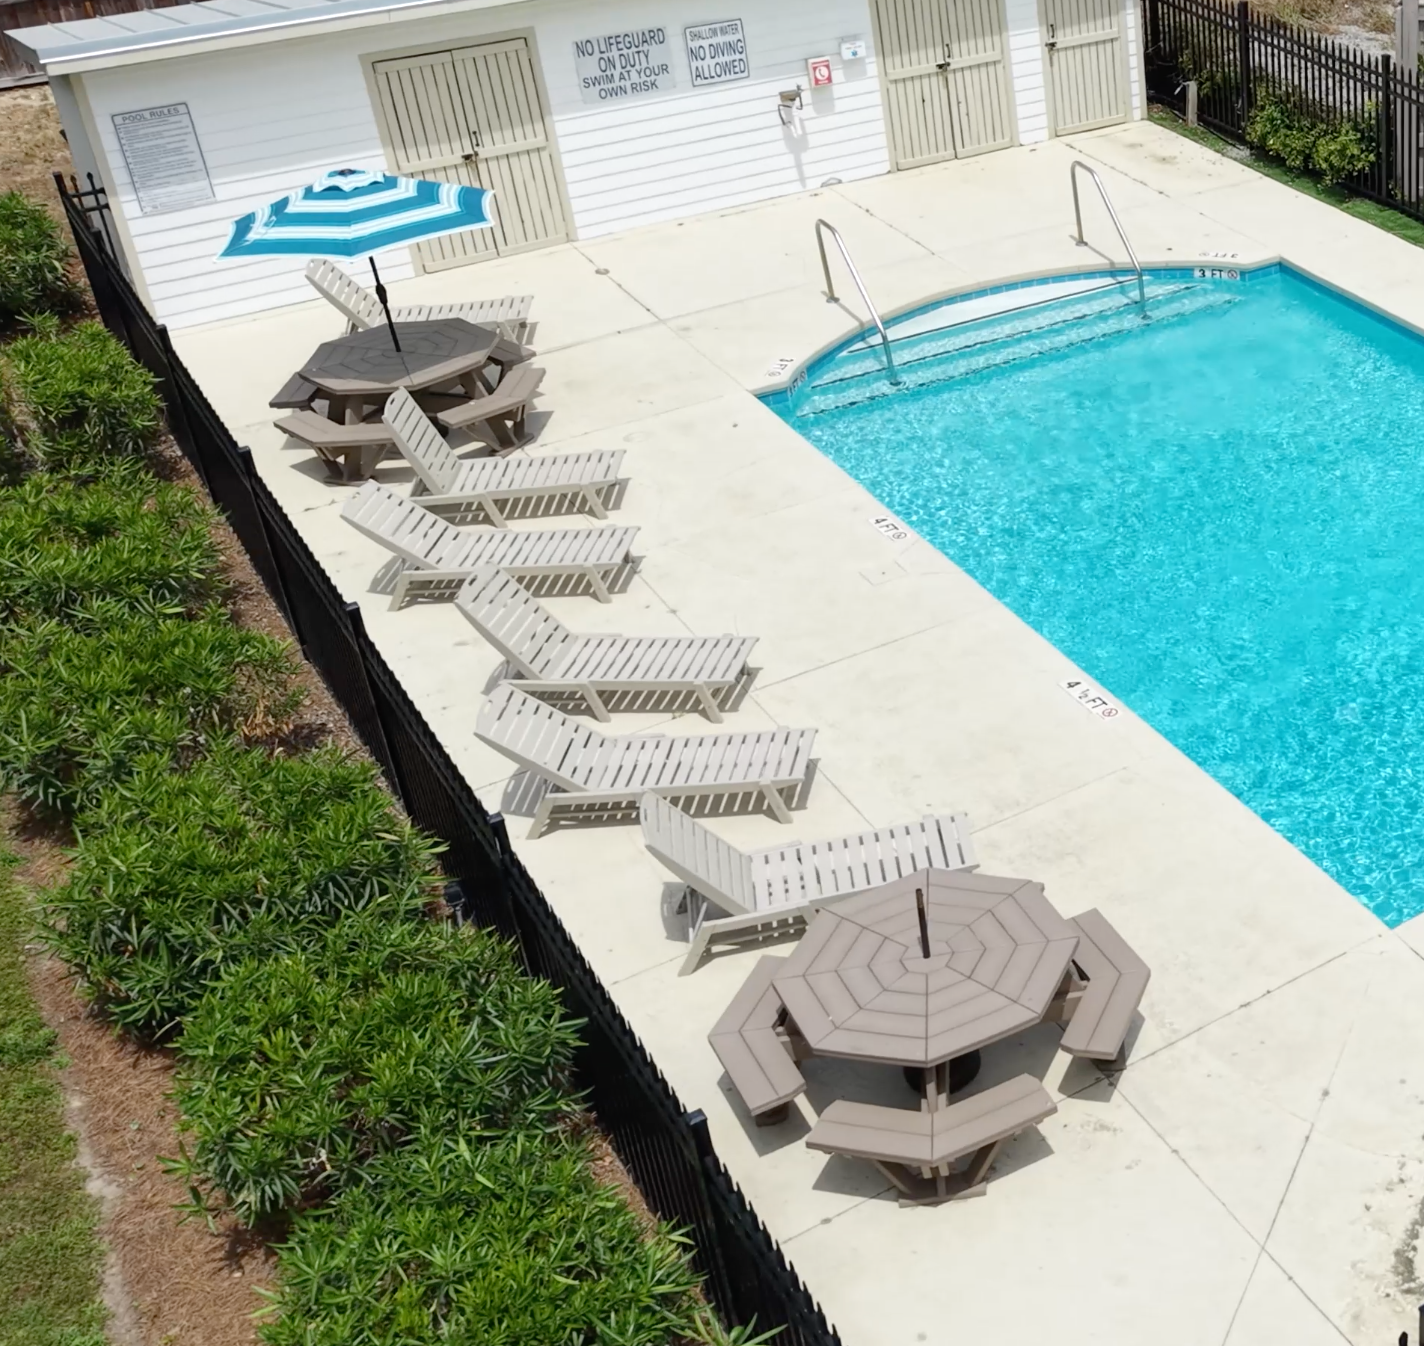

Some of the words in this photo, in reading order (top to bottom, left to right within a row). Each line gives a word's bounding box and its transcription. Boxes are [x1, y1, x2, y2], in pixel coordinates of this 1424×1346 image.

[575, 40, 595, 58] NO
[597, 28, 666, 54] LIFEGUARD
[689, 28, 719, 42] SHALLOW
[719, 23, 740, 36] WATER
[598, 56, 616, 73] ON
[620, 50, 650, 69] DUTY
[690, 46, 706, 62] NO
[709, 39, 745, 59] DIVING
[583, 73, 615, 89] SWIM
[618, 69, 632, 82] AT
[635, 64, 670, 79] YOUR
[695, 59, 746, 81] ALLOWED
[599, 86, 628, 100] OWN
[631, 79, 659, 94] RISK
[121, 114, 148, 123] POOL
[150, 107, 180, 118] RULES
[1198, 269, 1206, 278] 3
[1211, 269, 1224, 279] FT
[878, 523, 899, 533] FT
[1066, 681, 1081, 689] 4
[1085, 696, 1108, 709] FT
